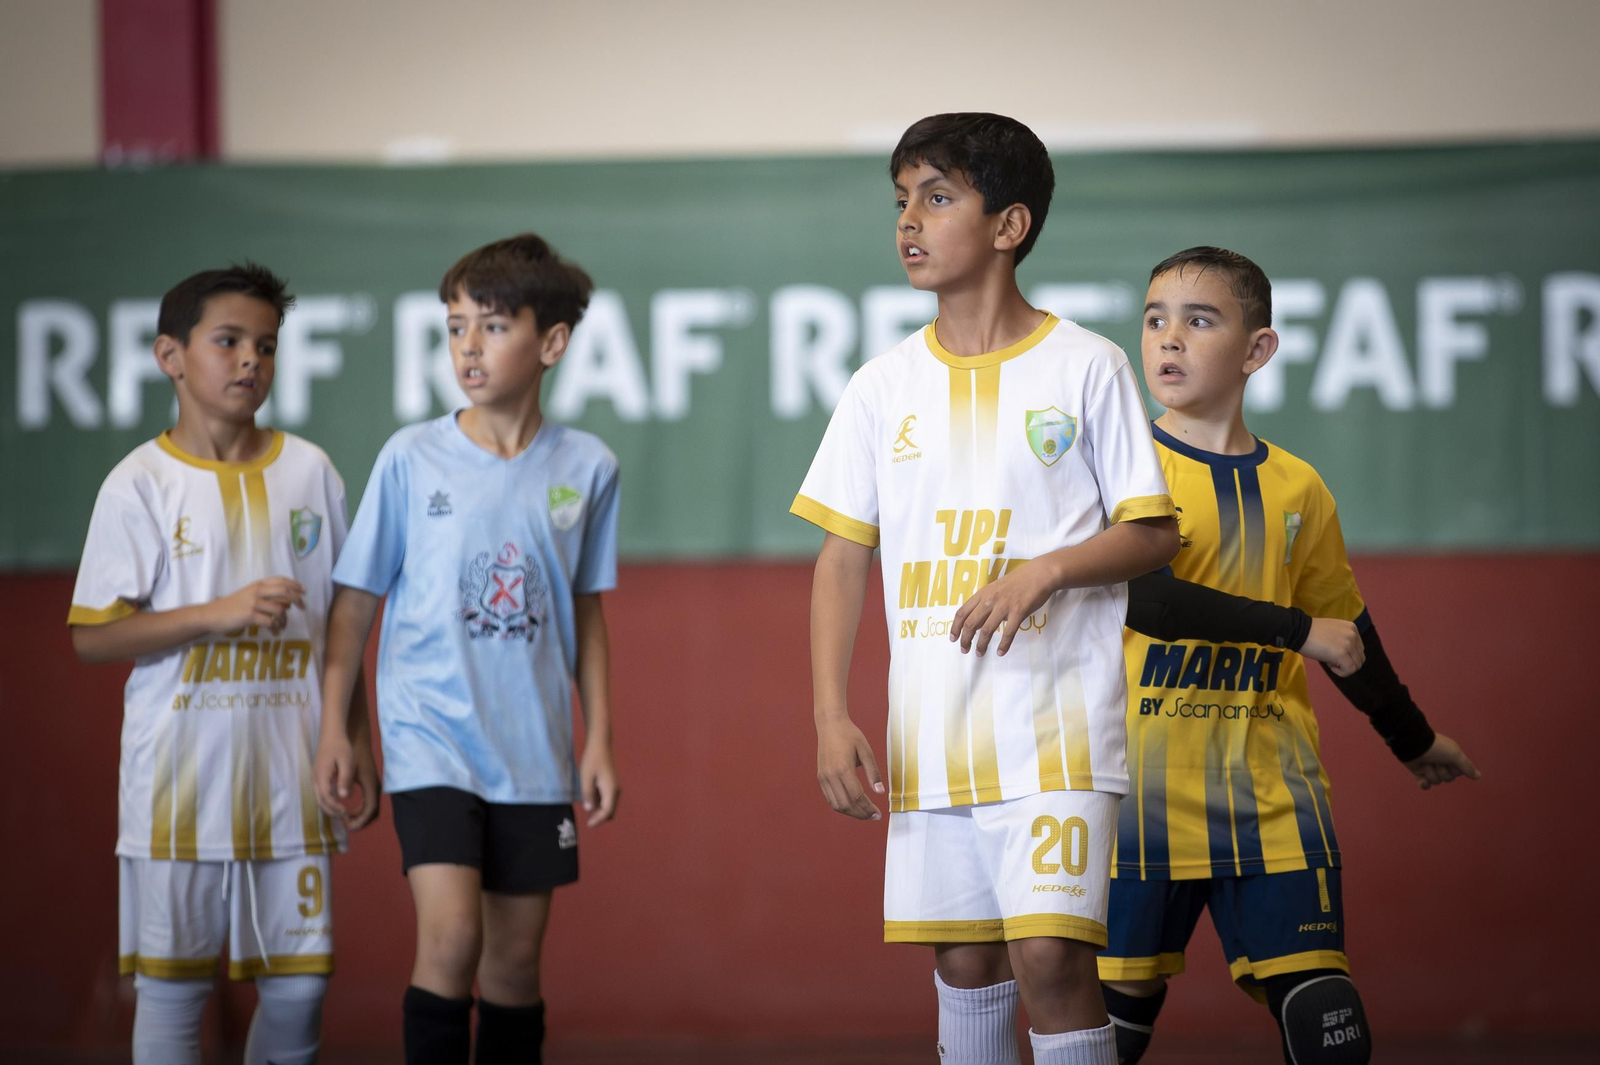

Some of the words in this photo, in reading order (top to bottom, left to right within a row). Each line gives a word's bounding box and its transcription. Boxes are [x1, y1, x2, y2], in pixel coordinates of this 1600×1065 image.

[17, 296, 347, 430] RFF
[393, 289, 725, 422] RAF
[936, 509, 1012, 556] UP!
[899, 558, 1034, 609] MARK
[901, 620, 918, 638] BY
[1139, 697, 1164, 716] BY
[1031, 815, 1089, 877] 20
[297, 865, 324, 918] 9
[1322, 1023, 1361, 1048] ADRI
